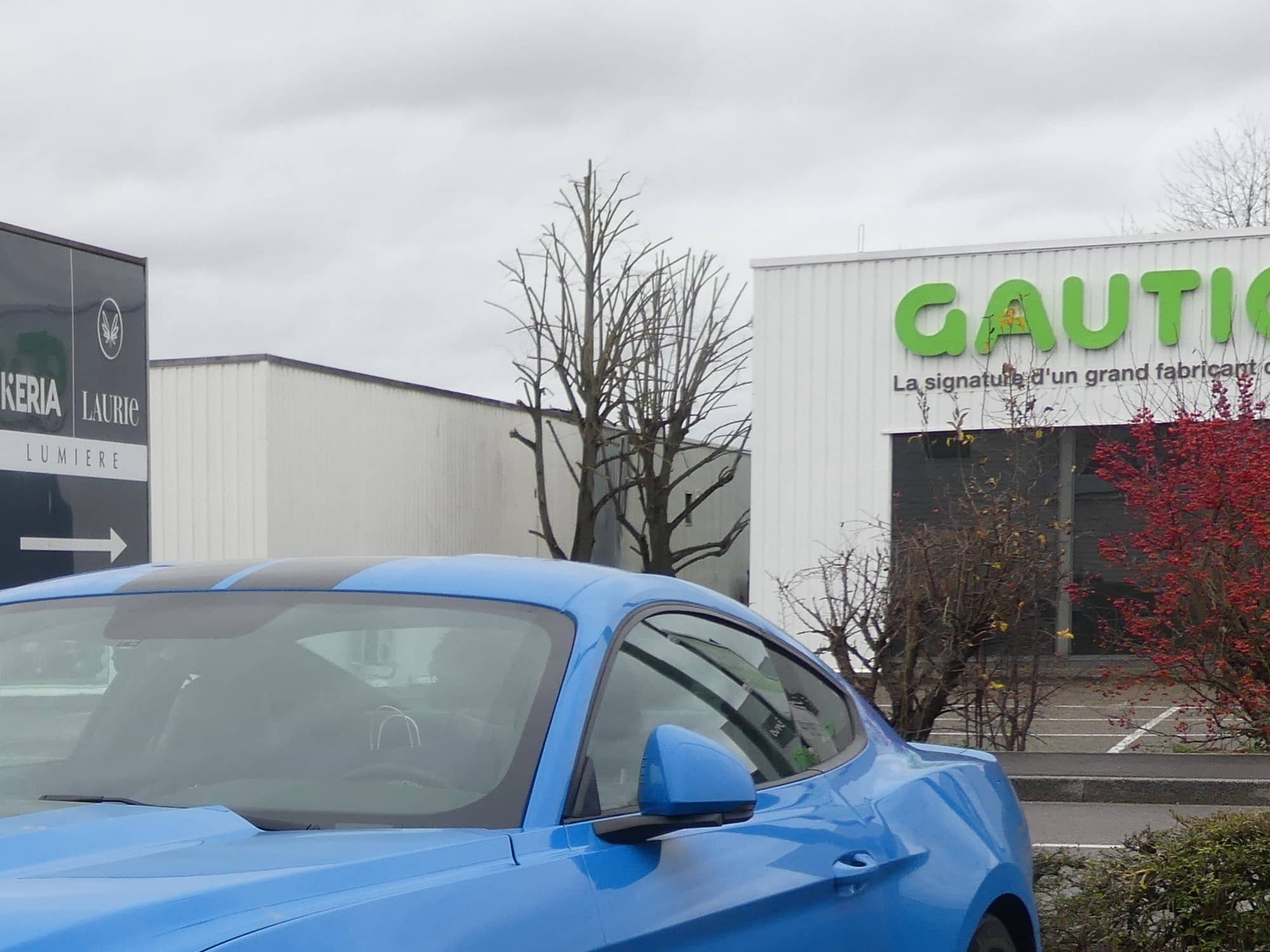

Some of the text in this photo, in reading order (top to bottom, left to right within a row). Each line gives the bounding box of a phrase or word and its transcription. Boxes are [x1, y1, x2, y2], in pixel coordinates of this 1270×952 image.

[0, 371, 62, 417] KERIA
[894, 374, 919, 392] La
[925, 372, 1024, 394] signature
[1031, 367, 1078, 386] d'un
[1085, 363, 1150, 387] grand
[1155, 359, 1257, 381] fabricant
[26, 443, 118, 470] LUMIERE
